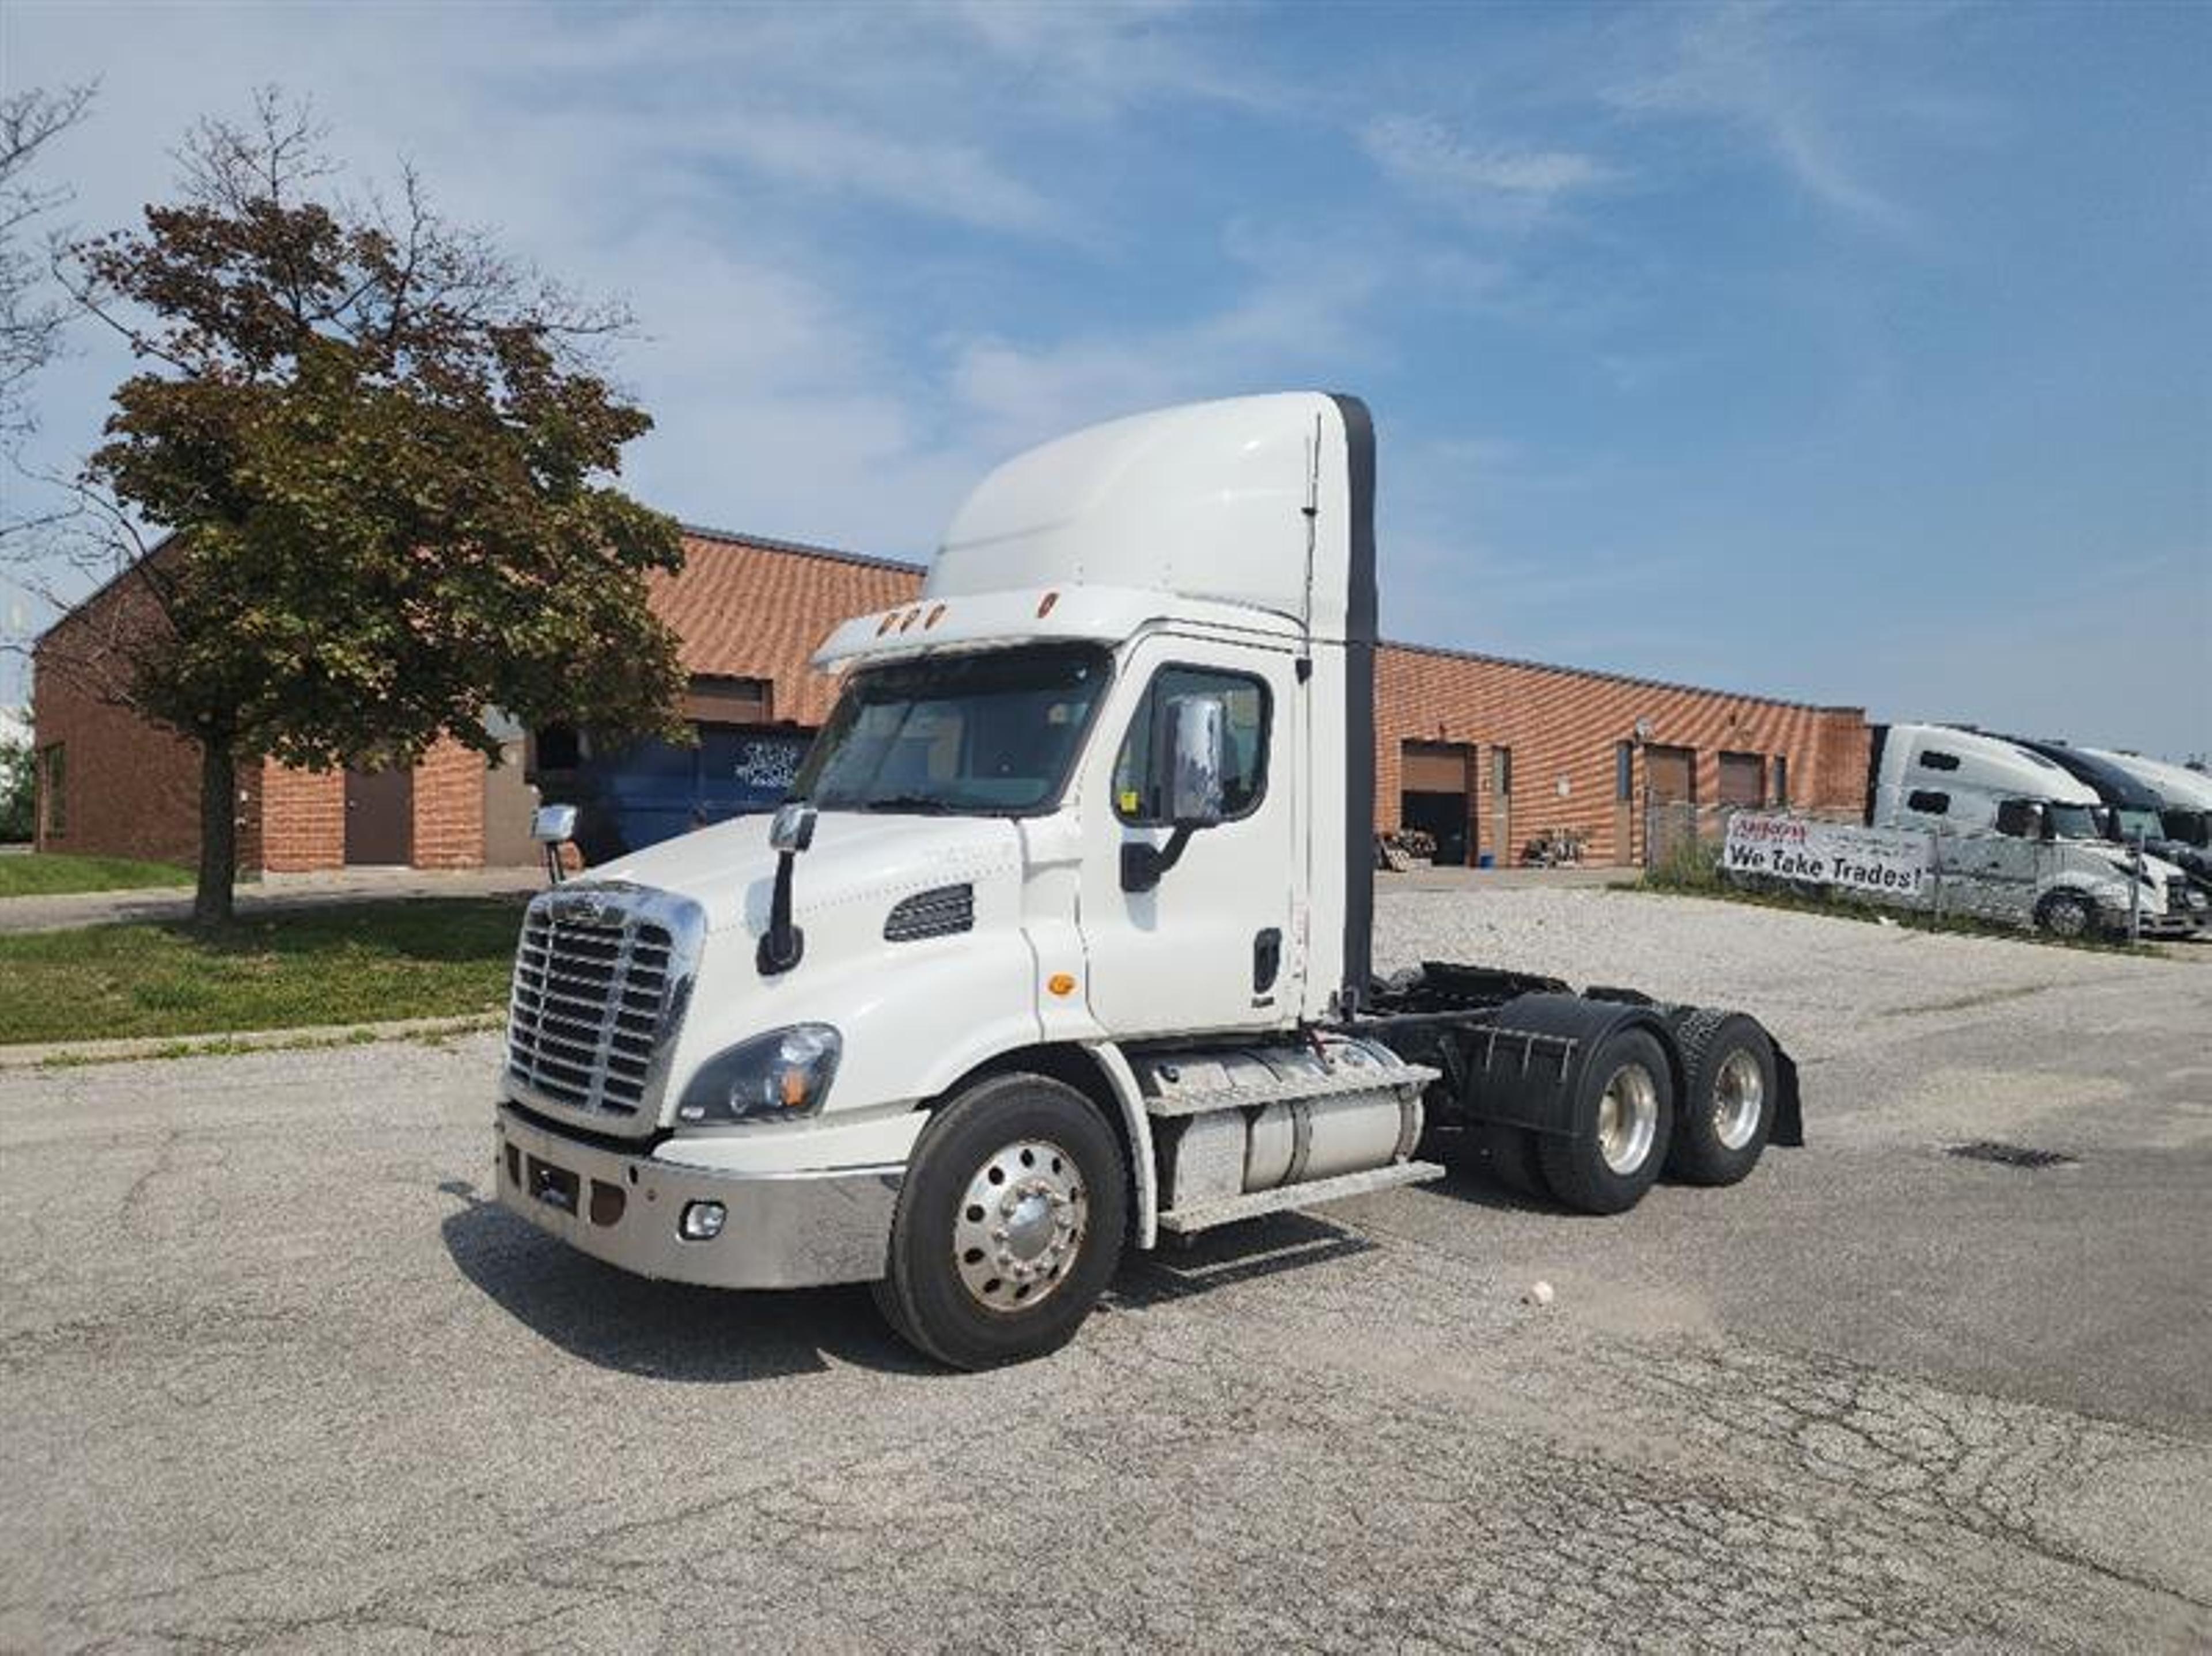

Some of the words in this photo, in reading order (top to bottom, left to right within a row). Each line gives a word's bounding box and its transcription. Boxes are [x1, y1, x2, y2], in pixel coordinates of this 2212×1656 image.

[1730, 844, 1764, 866] We
[1774, 850, 1823, 878] Take
[1832, 857, 1921, 889] Trades!
